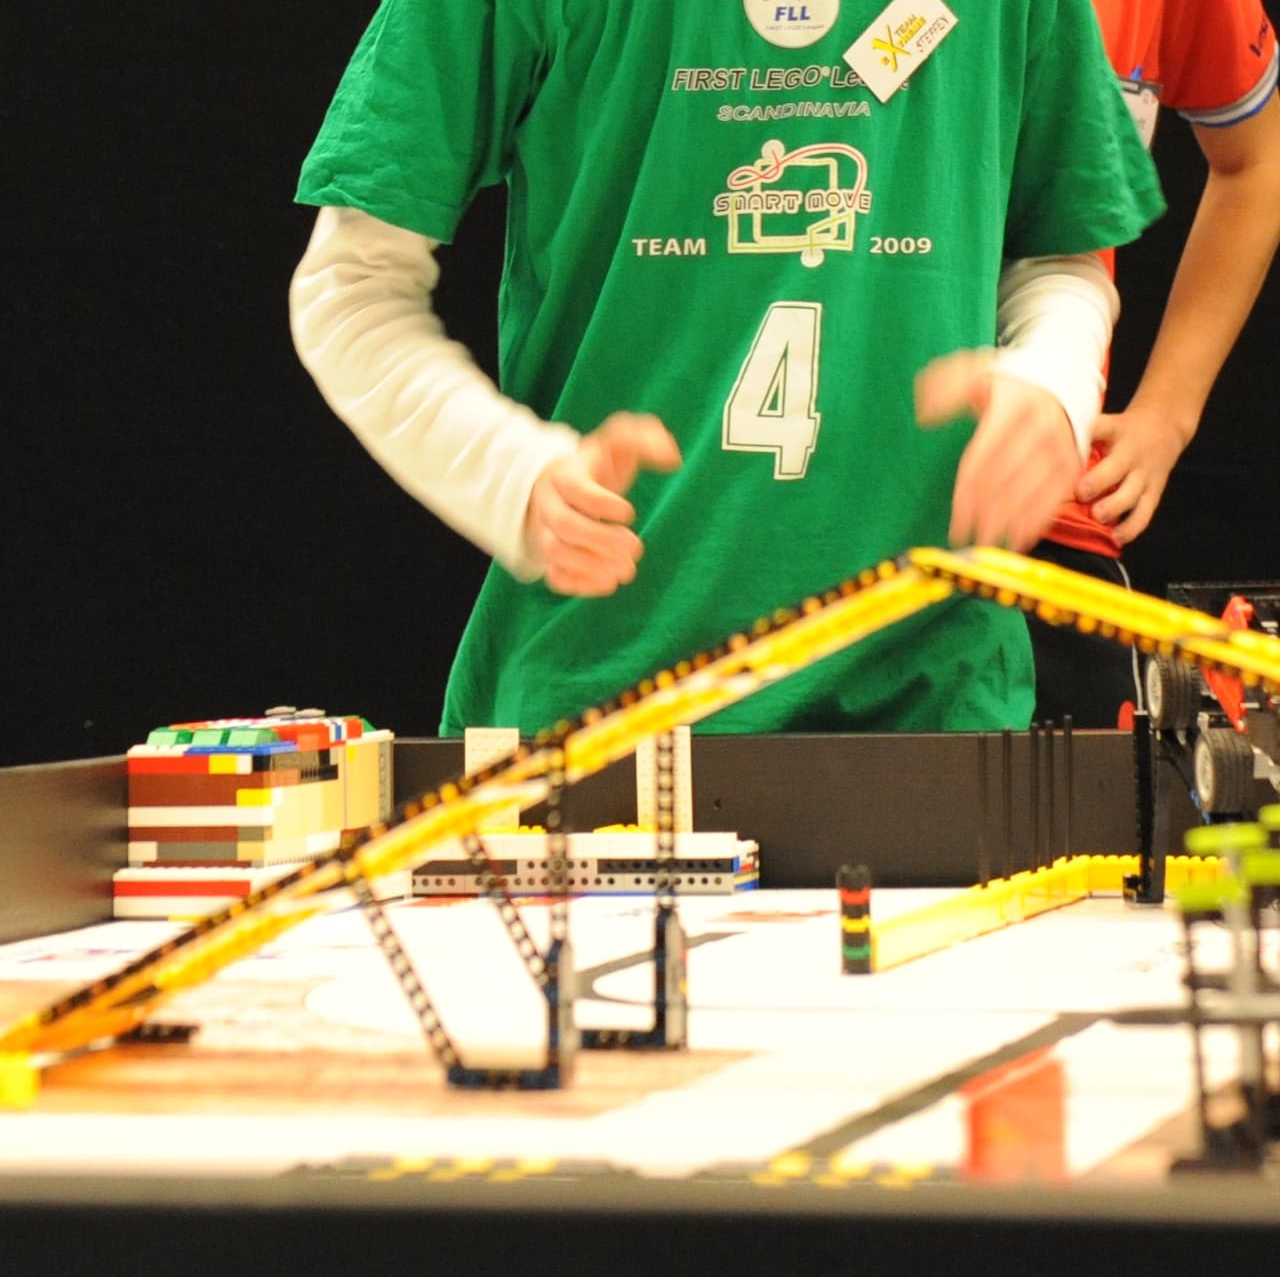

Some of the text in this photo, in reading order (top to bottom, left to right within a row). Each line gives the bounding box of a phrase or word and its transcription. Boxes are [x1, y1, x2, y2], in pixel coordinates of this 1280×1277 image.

[774, 5, 811, 22] FLL
[671, 67, 747, 91] FIRST
[717, 101, 872, 122] SCANDINAVIA
[714, 191, 871, 214] SMART MOVE
[632, 238, 706, 256] TEAM
[869, 237, 932, 255] 2009
[721, 300, 822, 480] 4
